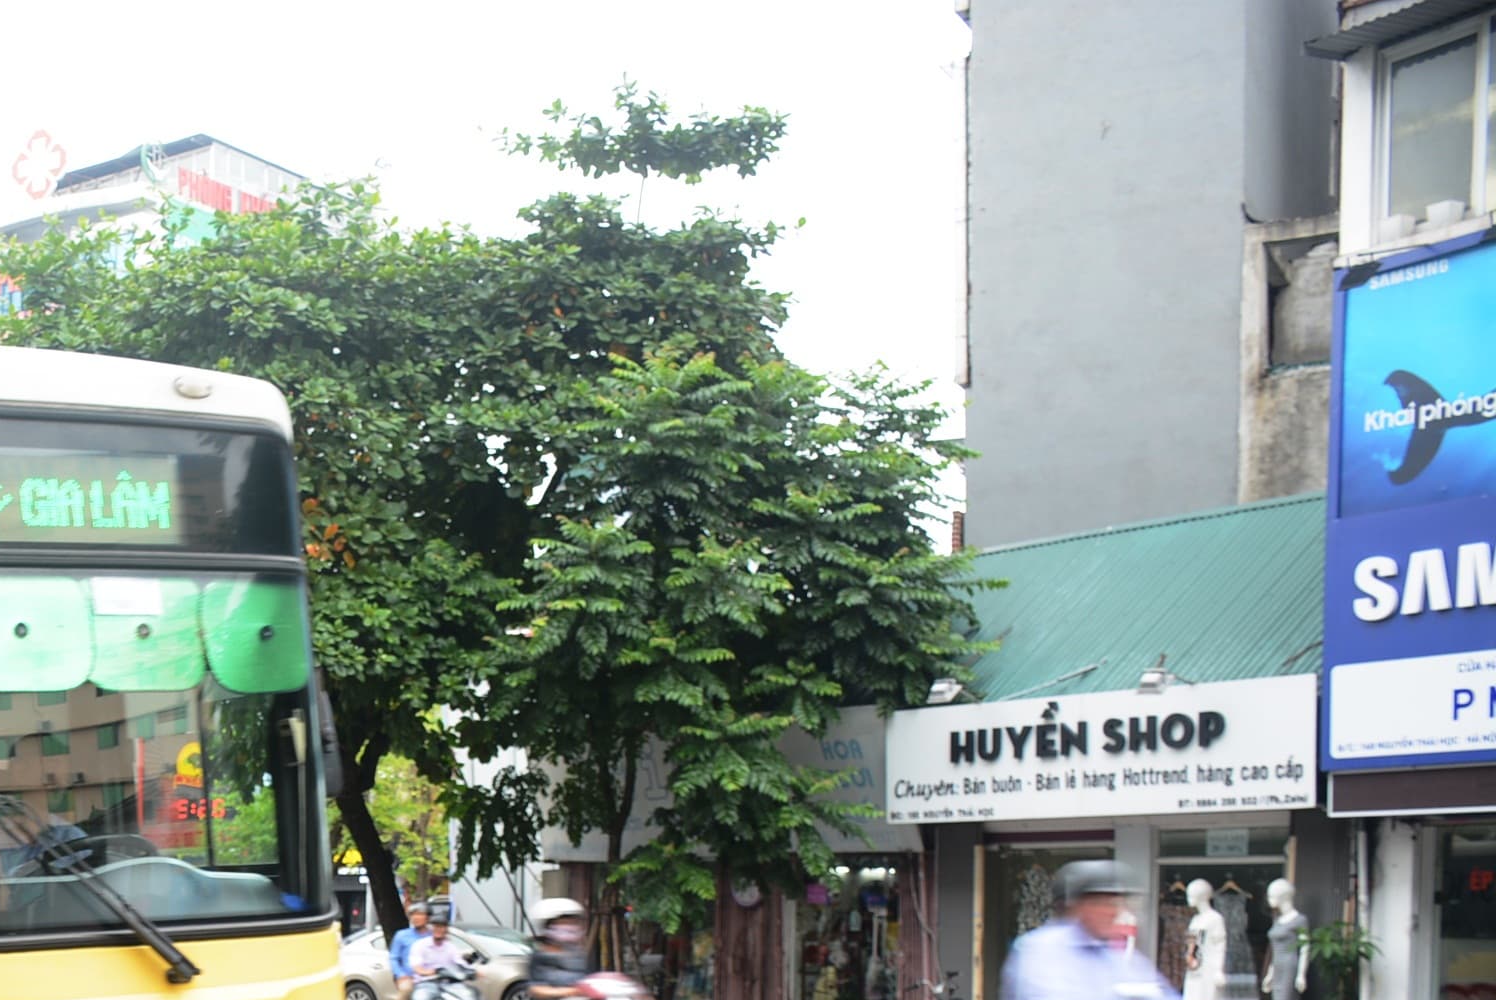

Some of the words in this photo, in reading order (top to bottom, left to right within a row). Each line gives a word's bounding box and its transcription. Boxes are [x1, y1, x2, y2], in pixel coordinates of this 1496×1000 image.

[1369, 259, 1449, 290] SAMSUNG
[1364, 401, 1416, 432] Khai
[1418, 391, 1496, 430] phóng
[90, 470, 171, 529] LÂM
[1102, 711, 1226, 754] SHOP
[1241, 764, 1269, 780] cao
[1275, 755, 1304, 782] cấp
